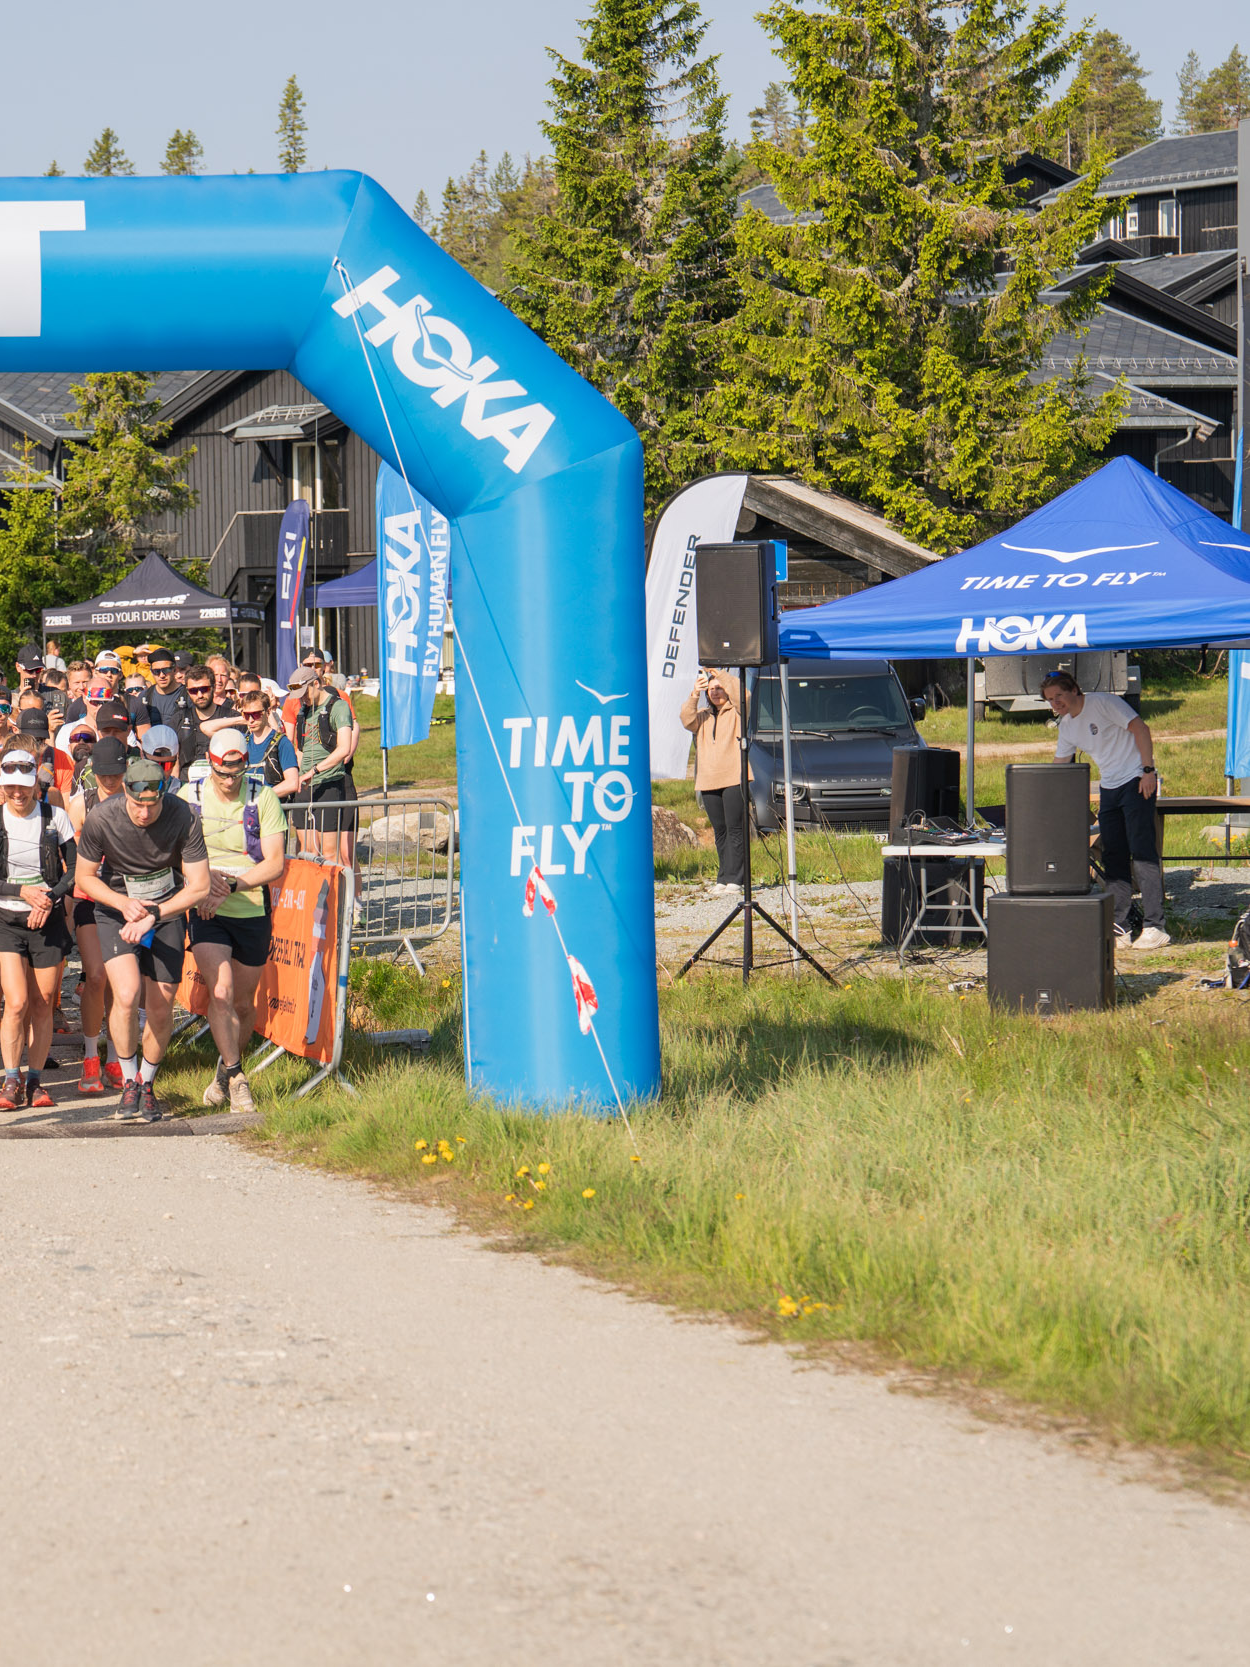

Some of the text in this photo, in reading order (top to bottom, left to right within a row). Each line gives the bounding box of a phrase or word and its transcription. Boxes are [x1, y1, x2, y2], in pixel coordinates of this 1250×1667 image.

[331, 264, 556, 474] HOKA
[384, 509, 421, 677] HOKA
[422, 507, 449, 677] FLY HUMAN FLY
[662, 534, 701, 679] DEFENDER
[960, 574, 1040, 590] TIME
[1042, 573, 1089, 588] TO
[1092, 571, 1152, 586] FLY
[45, 615, 72, 627] 226ERS
[91, 610, 181, 625] FEED YOUR DREAMS
[199, 607, 227, 619] 226ERS
[955, 613, 1089, 653] HOKA
[503, 715, 630, 768] TIME
[564, 770, 635, 823] TO
[510, 823, 600, 877] FLY
